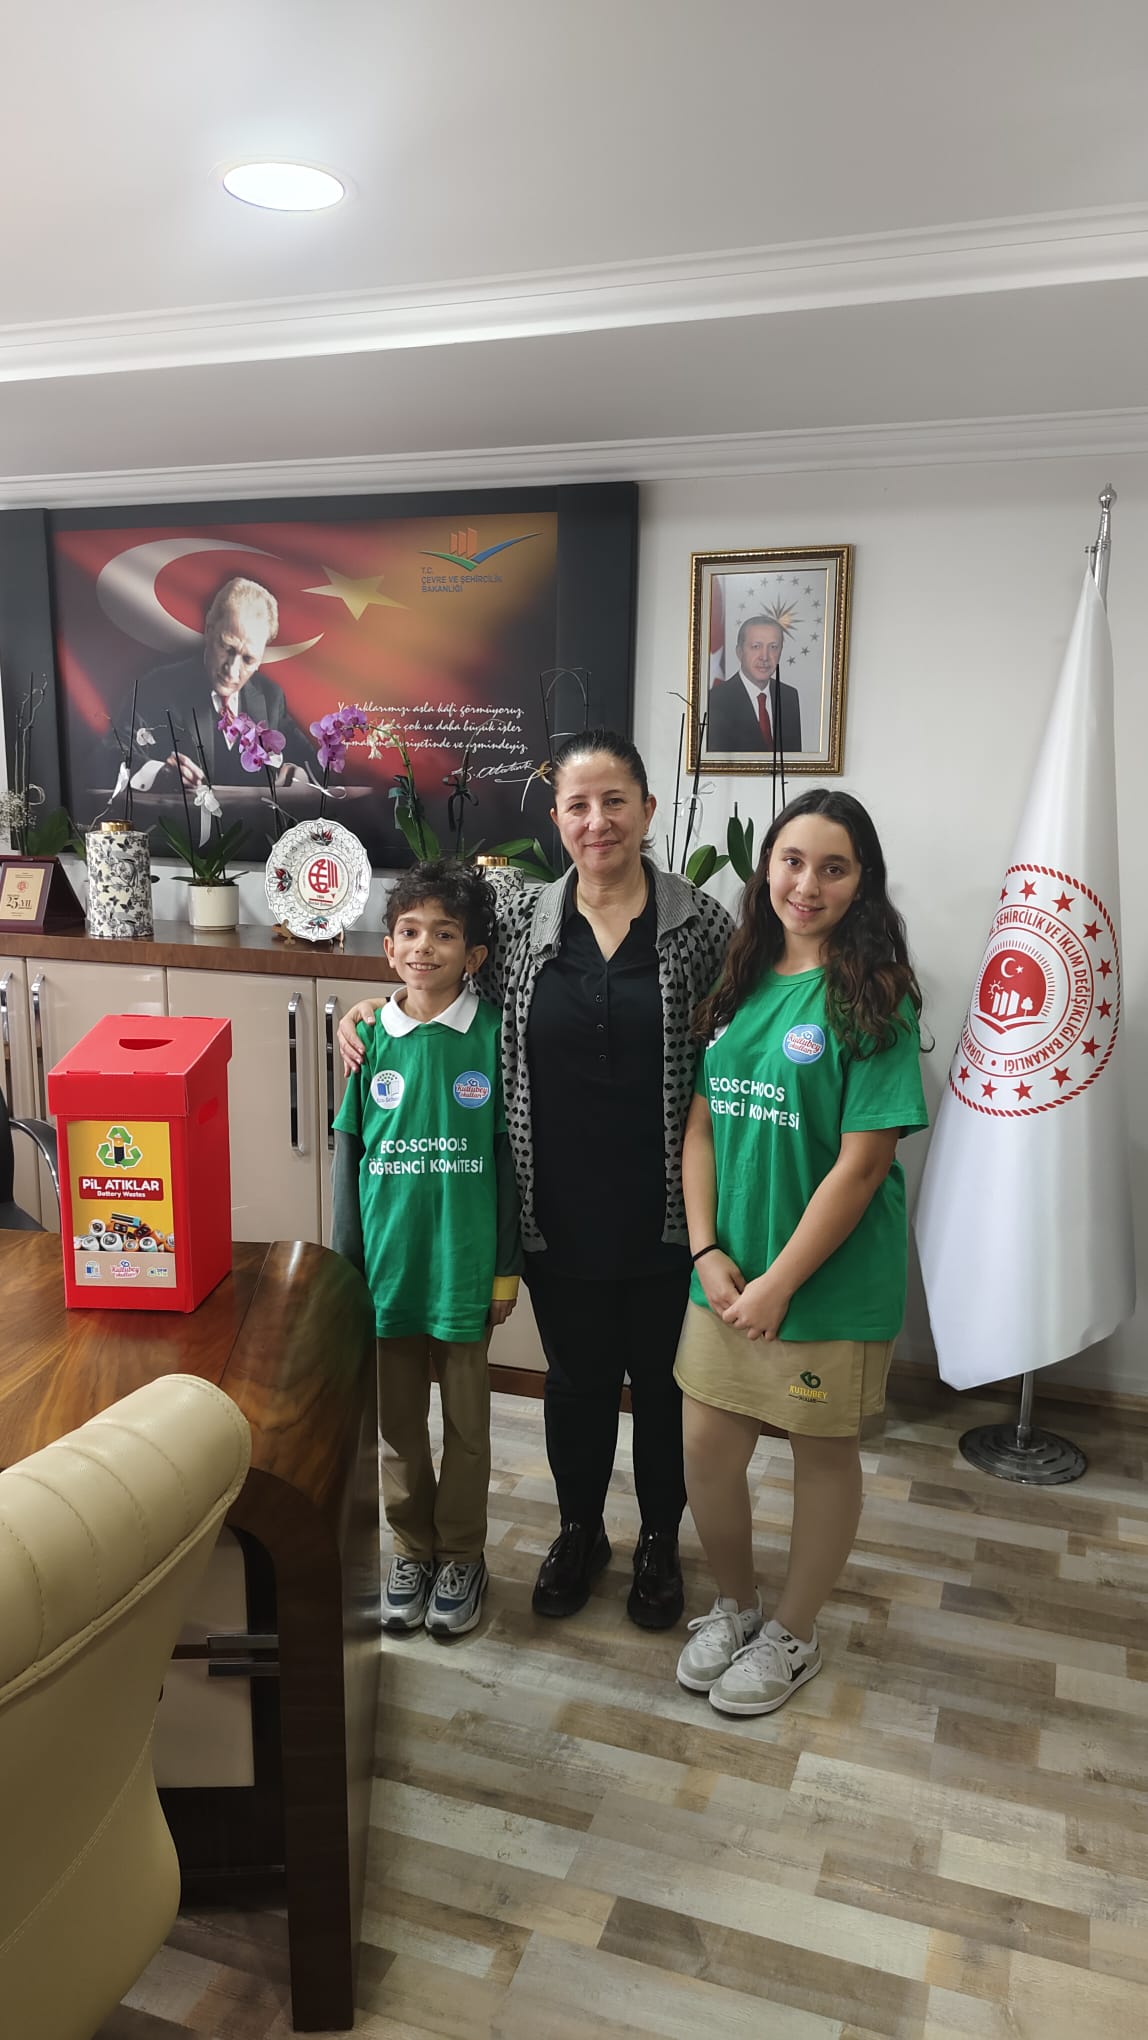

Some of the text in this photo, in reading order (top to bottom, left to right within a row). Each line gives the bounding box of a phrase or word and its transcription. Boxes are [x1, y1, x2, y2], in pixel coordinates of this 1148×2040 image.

[421, 575, 446, 585] ÇEVRE
[421, 584, 463, 592] BAKANLIĞI
[435, 720, 461, 732] daha
[463, 720, 496, 735] büyük
[497, 720, 523, 734] işler
[452, 741, 465, 749] ve
[996, 908, 1046, 930] ŞEHİRCİLİK
[1044, 921, 1061, 939] VE
[1056, 931, 1085, 968] İKLİM
[1059, 969, 1091, 1043] DEĞİŞİKLİĞİ
[1004, 1038, 1065, 1074] BAKANLIĞI
[380, 1137, 468, 1154] ECO-SCHOOLS
[368, 1156, 484, 1176] ÖĞRENCİ KOMİTESİ
[104, 1179, 160, 1191] ATIKLAR
[97, 1190, 122, 1198] Battery
[789, 1384, 828, 1399] KUTLUBEY
